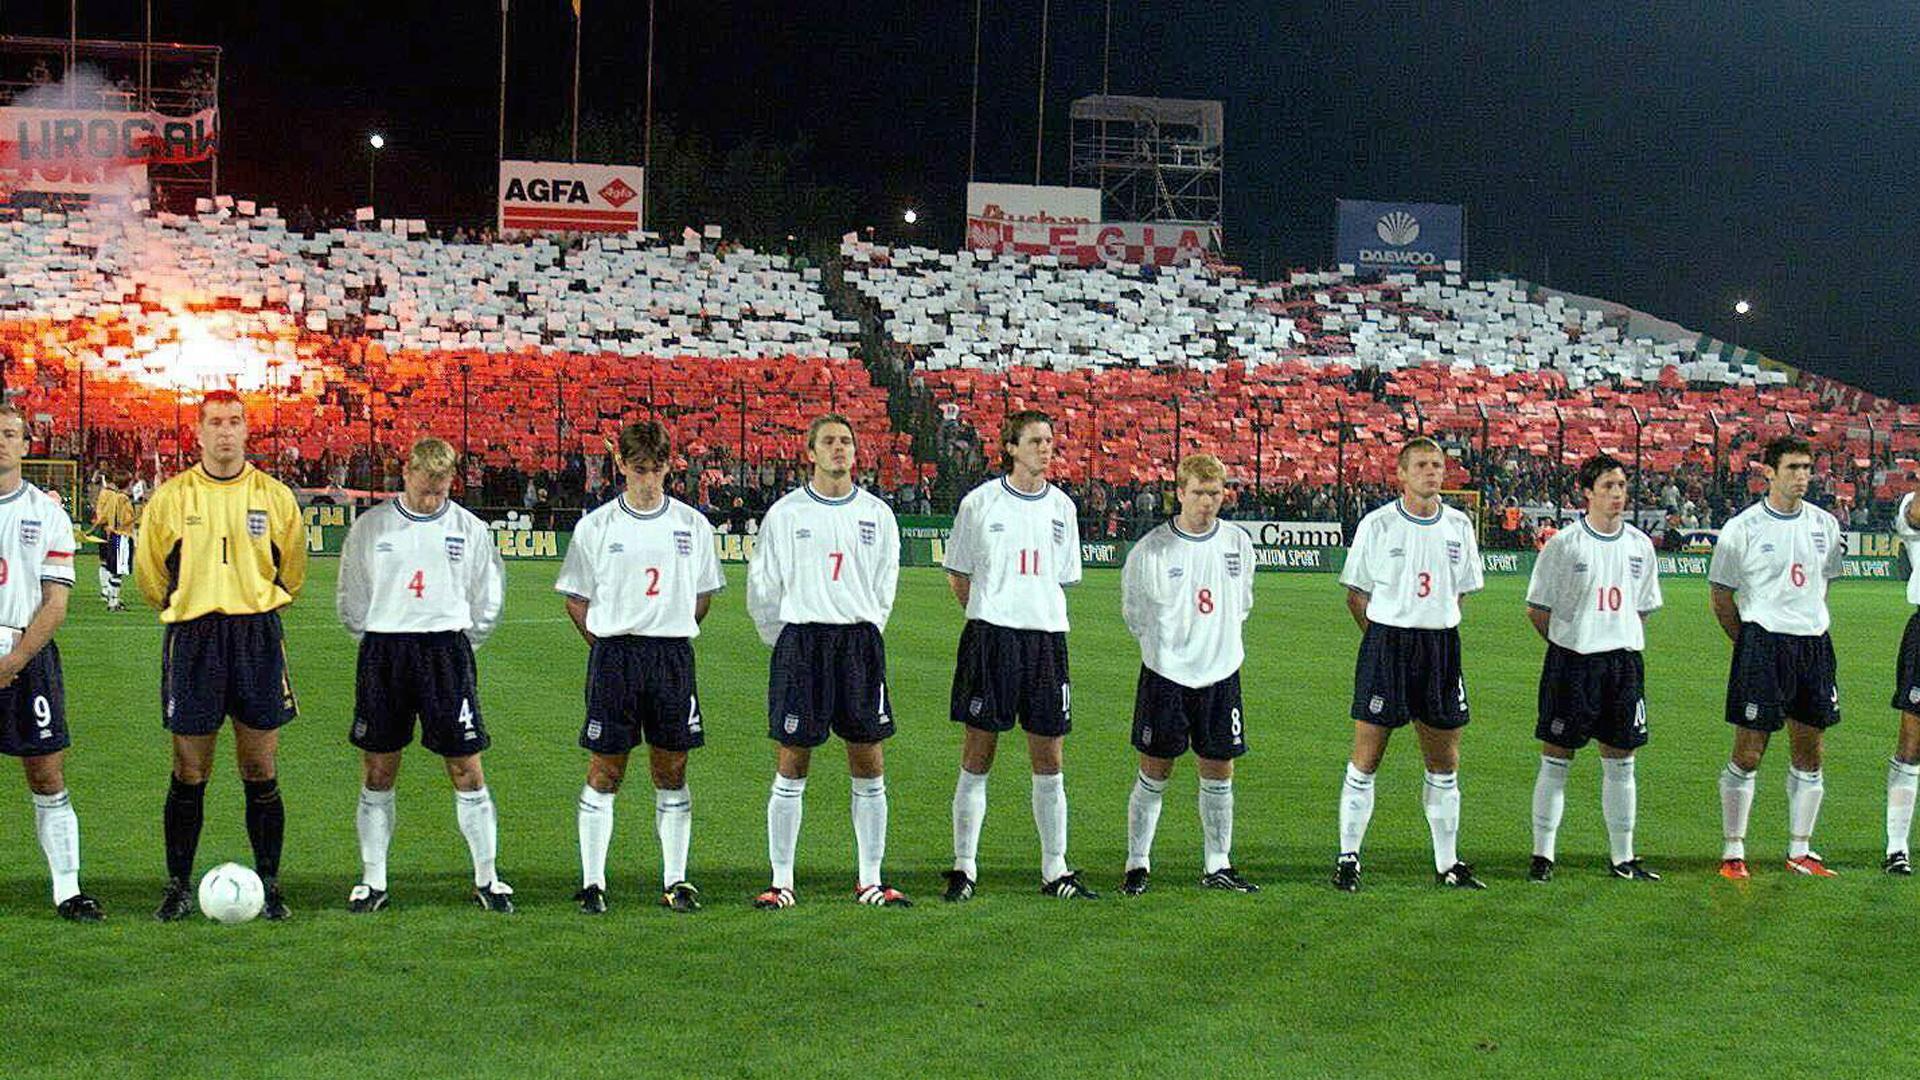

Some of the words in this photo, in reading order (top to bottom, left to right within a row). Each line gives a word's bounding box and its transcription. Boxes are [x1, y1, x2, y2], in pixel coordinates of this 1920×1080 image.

[505, 178, 590, 204] AGFA
[1003, 224, 1204, 265] LEGIA
[1360, 250, 1434, 264] DAEWOO
[222, 537, 228, 565] 1
[496, 530, 557, 557] ECH
[1082, 544, 1115, 562] SPORT
[829, 552, 843, 581] 7
[1019, 548, 1039, 576] 11
[1287, 550, 1320, 567] SPORT
[408, 570, 425, 598] 4
[646, 568, 660, 596] 2
[1417, 573, 1431, 598] 3
[1790, 563, 1806, 588] 6
[1197, 588, 1214, 615] 8
[1597, 586, 1622, 612] 10
[33, 695, 51, 728] 9
[458, 698, 474, 729] 4
[1231, 707, 1242, 737] 8
